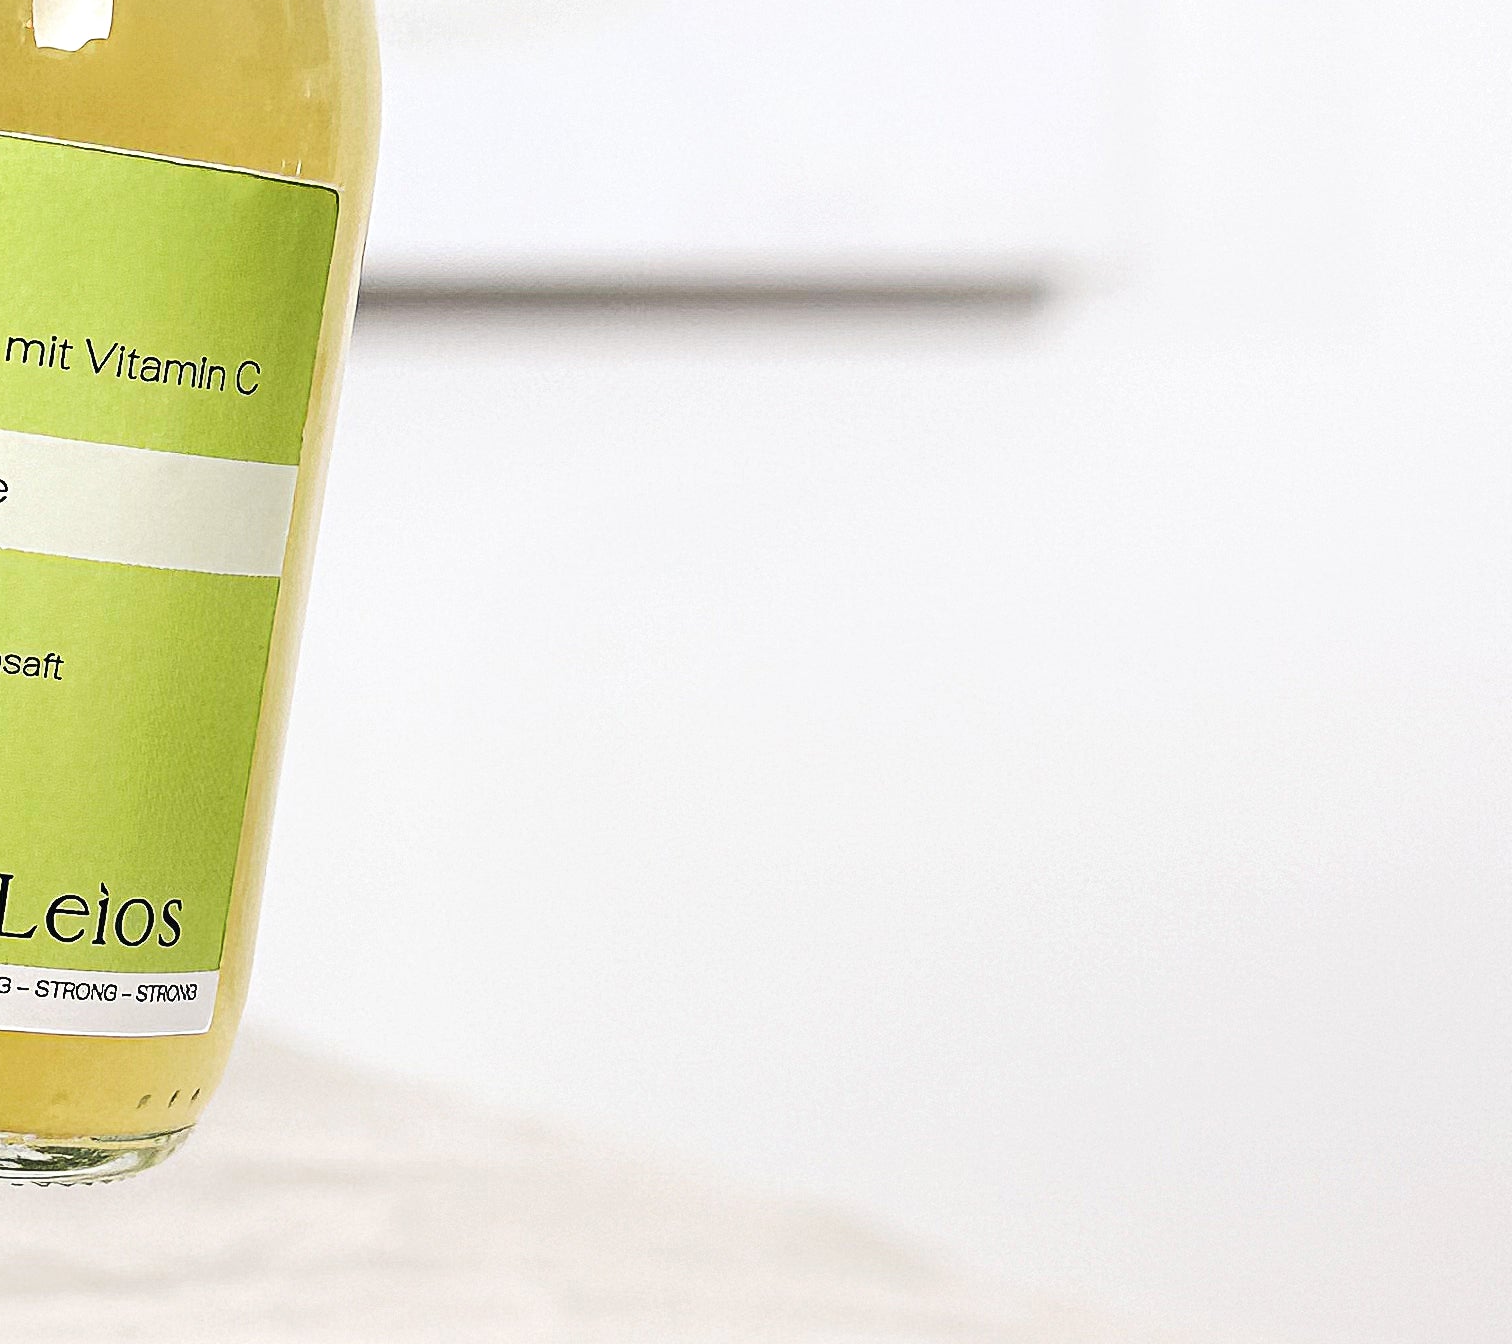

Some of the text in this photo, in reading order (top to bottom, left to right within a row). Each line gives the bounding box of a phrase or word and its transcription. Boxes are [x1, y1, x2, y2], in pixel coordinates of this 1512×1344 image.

[5, 335, 74, 371] mit
[85, 338, 226, 392] Vitamin
[236, 360, 261, 396] C
[34, 979, 118, 1002] STRONG
[135, 983, 198, 1003] STRONG
